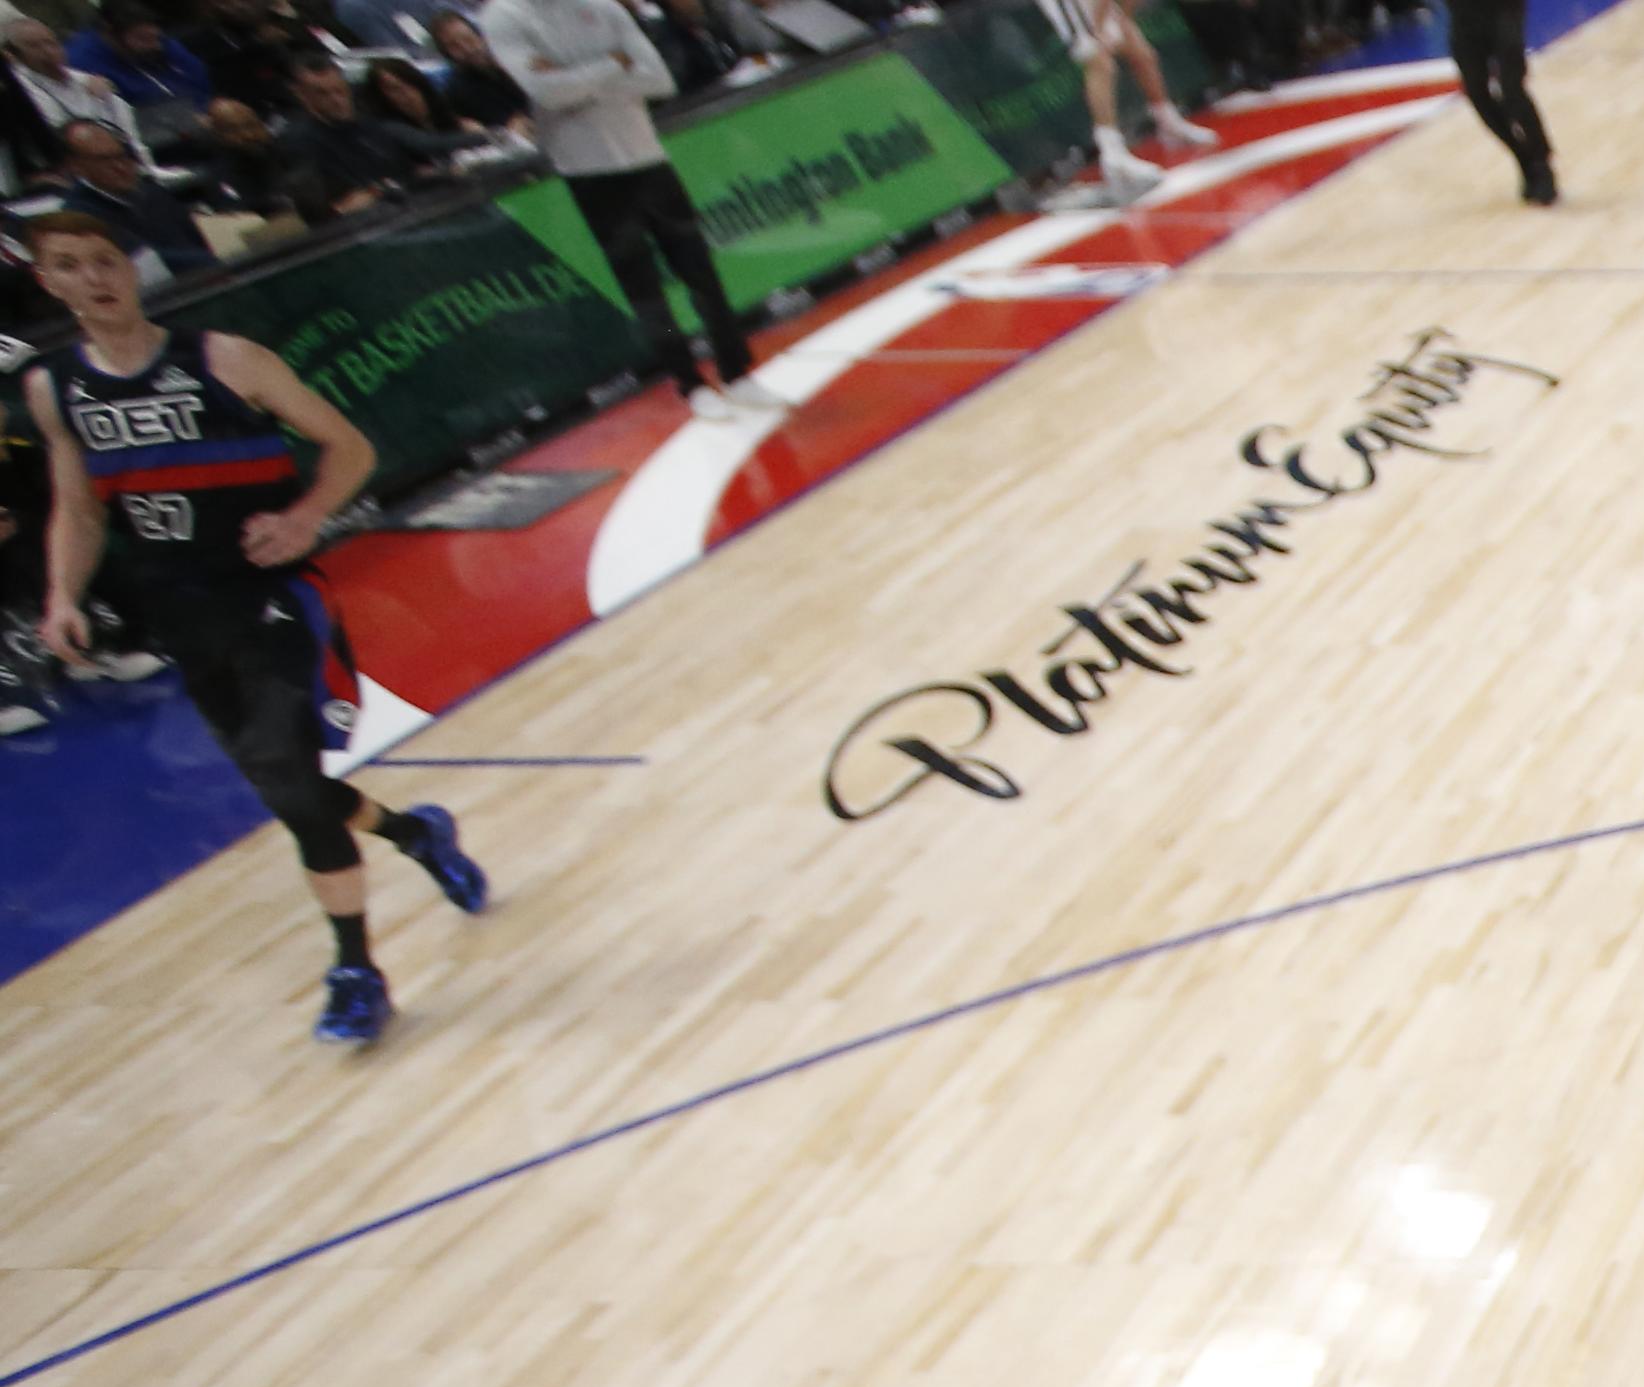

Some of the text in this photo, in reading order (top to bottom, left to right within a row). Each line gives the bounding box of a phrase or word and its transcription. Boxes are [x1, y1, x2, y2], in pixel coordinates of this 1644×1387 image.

[69, 392, 206, 451] DET
[823, 326, 1560, 822] Platinum Equity
